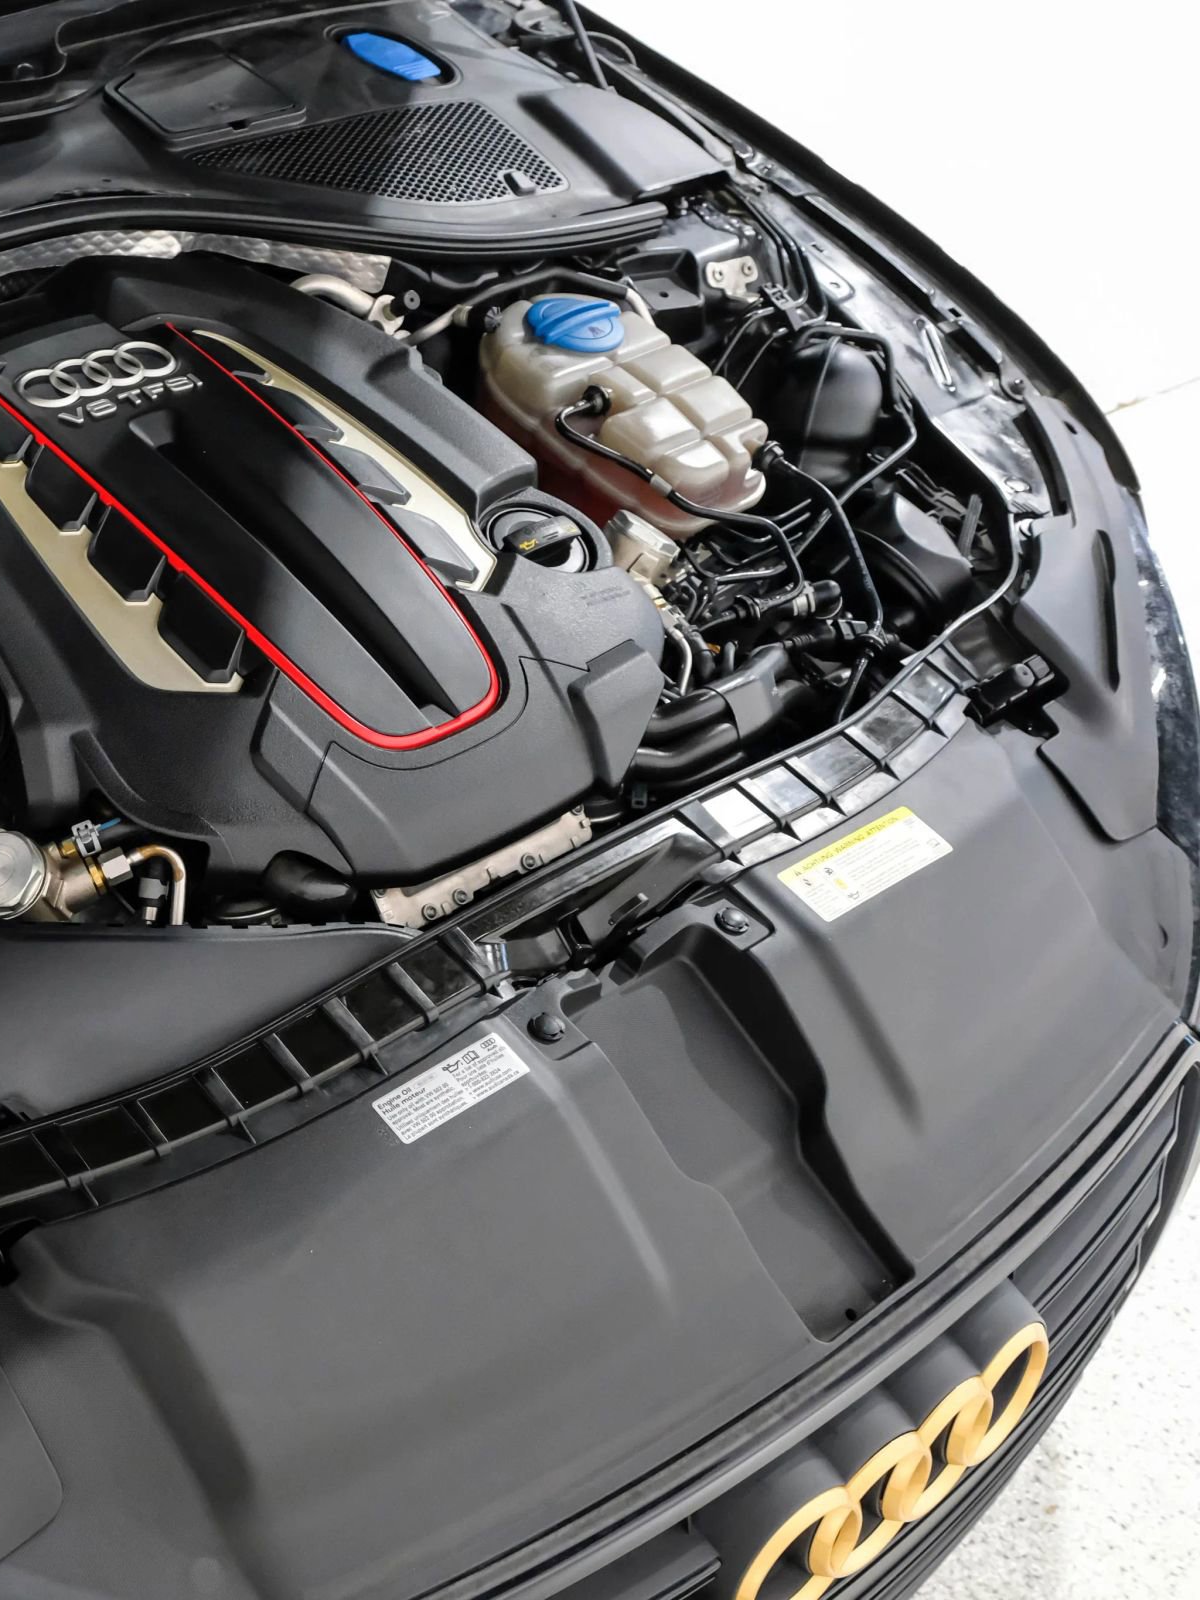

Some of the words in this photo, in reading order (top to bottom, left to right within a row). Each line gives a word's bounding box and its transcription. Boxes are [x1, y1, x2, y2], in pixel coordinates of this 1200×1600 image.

[117, 373, 203, 405] TFSI
[377, 1094, 402, 1111] Engine
[400, 1087, 412, 1096] Oil
[382, 1103, 401, 1116] Huile
[400, 1087, 427, 1105] moteur
[397, 1107, 408, 1115] only
[414, 1096, 426, 1105] with
[413, 1104, 426, 1113] Most
